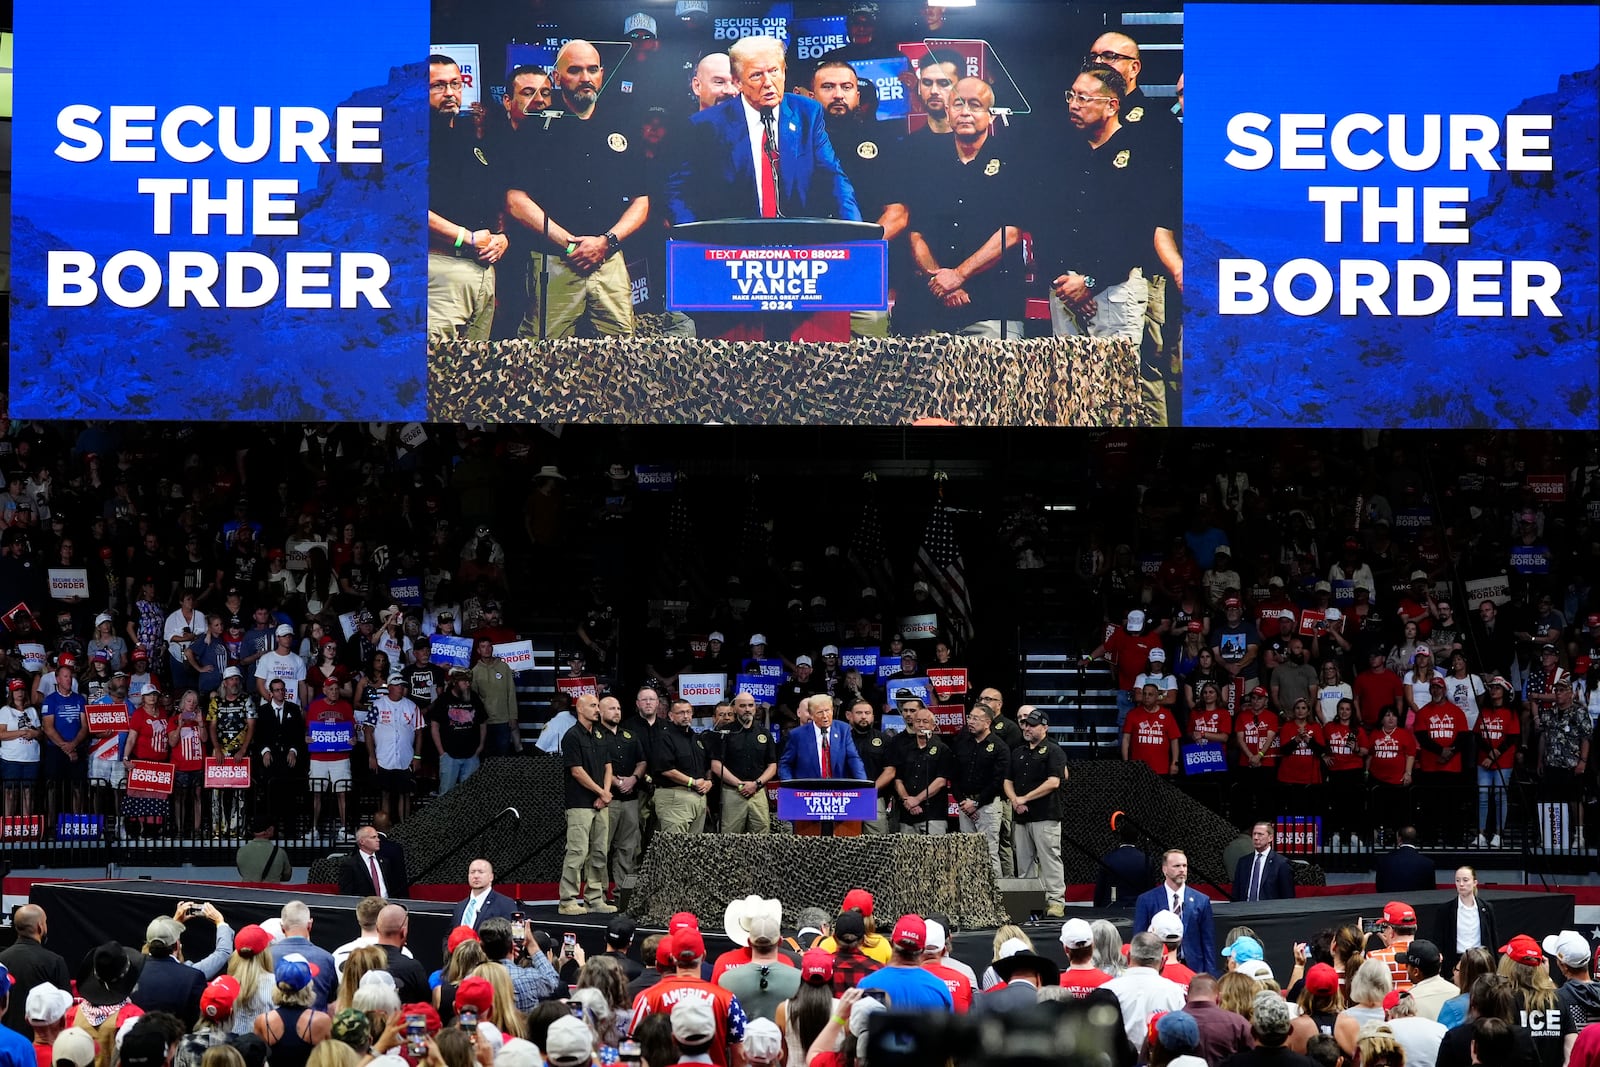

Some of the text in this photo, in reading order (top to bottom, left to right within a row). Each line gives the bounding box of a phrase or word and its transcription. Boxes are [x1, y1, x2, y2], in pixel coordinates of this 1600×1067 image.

[714, 17, 787, 27] SECURE OUR
[714, 26, 787, 40] BORDER
[798, 35, 843, 46] SECURE
[798, 44, 846, 60] BOR
[876, 77, 903, 87] OUR
[54, 104, 383, 163] SECURE
[1224, 112, 1553, 171] SECURE
[138, 178, 299, 236] THE
[1308, 186, 1470, 243] THE
[709, 250, 845, 259] TEXT ARIZONA TO 88022
[726, 260, 829, 279] TRUMP
[47, 250, 392, 308] BORDER
[630, 277, 647, 290] OUR
[737, 279, 817, 294] VANCE
[1218, 258, 1564, 317] BORDER
[761, 301, 793, 310] 2024
[1335, 591, 1355, 599] BOR
[430, 648, 468, 659] BORDER
[500, 654, 530, 663] ORDER
[842, 659, 877, 667] BORDER
[760, 669, 780, 677] RDER
[90, 716, 127, 724] BORDER
[935, 718, 963, 726] ORDER
[312, 735, 350, 743] BORDER
[1138, 736, 1163, 744] TRUMP
[1430, 731, 1454, 739] TRUMP
[1186, 751, 1208, 759] SECURE
[1186, 755, 1223, 766] BORDER
[132, 768, 157, 776] SECURE
[208, 770, 248, 778] BORDER
[131, 773, 171, 784] BORDER
[804, 797, 851, 806] TRUMP
[809, 805, 846, 813] VANCE
[901, 931, 919, 939] MAGA
[1520, 1009, 1561, 1030] ICE
